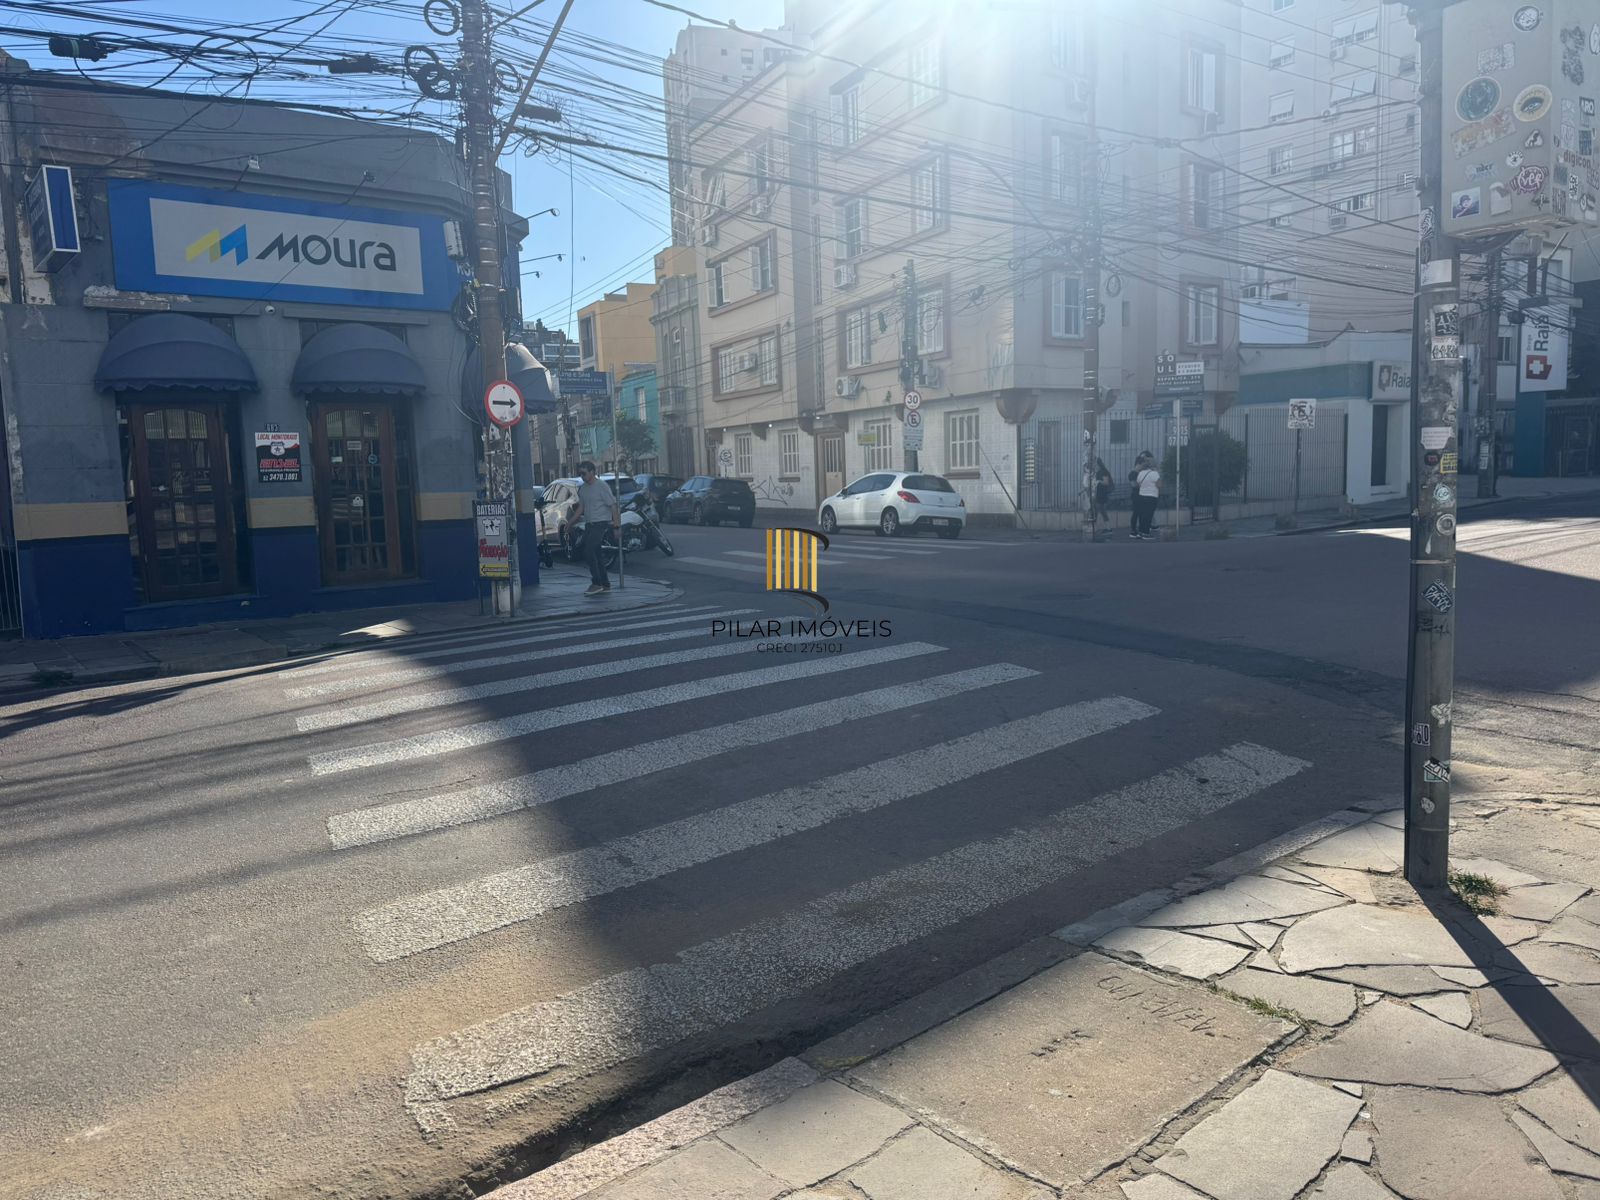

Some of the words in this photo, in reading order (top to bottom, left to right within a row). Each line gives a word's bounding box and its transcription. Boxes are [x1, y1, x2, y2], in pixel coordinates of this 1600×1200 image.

[1563, 149, 1591, 168] digicon
[255, 232, 398, 272] Moura
[1533, 314, 1549, 351] Raia
[907, 395, 918, 404] 30
[476, 504, 506, 515] BATERIAS
